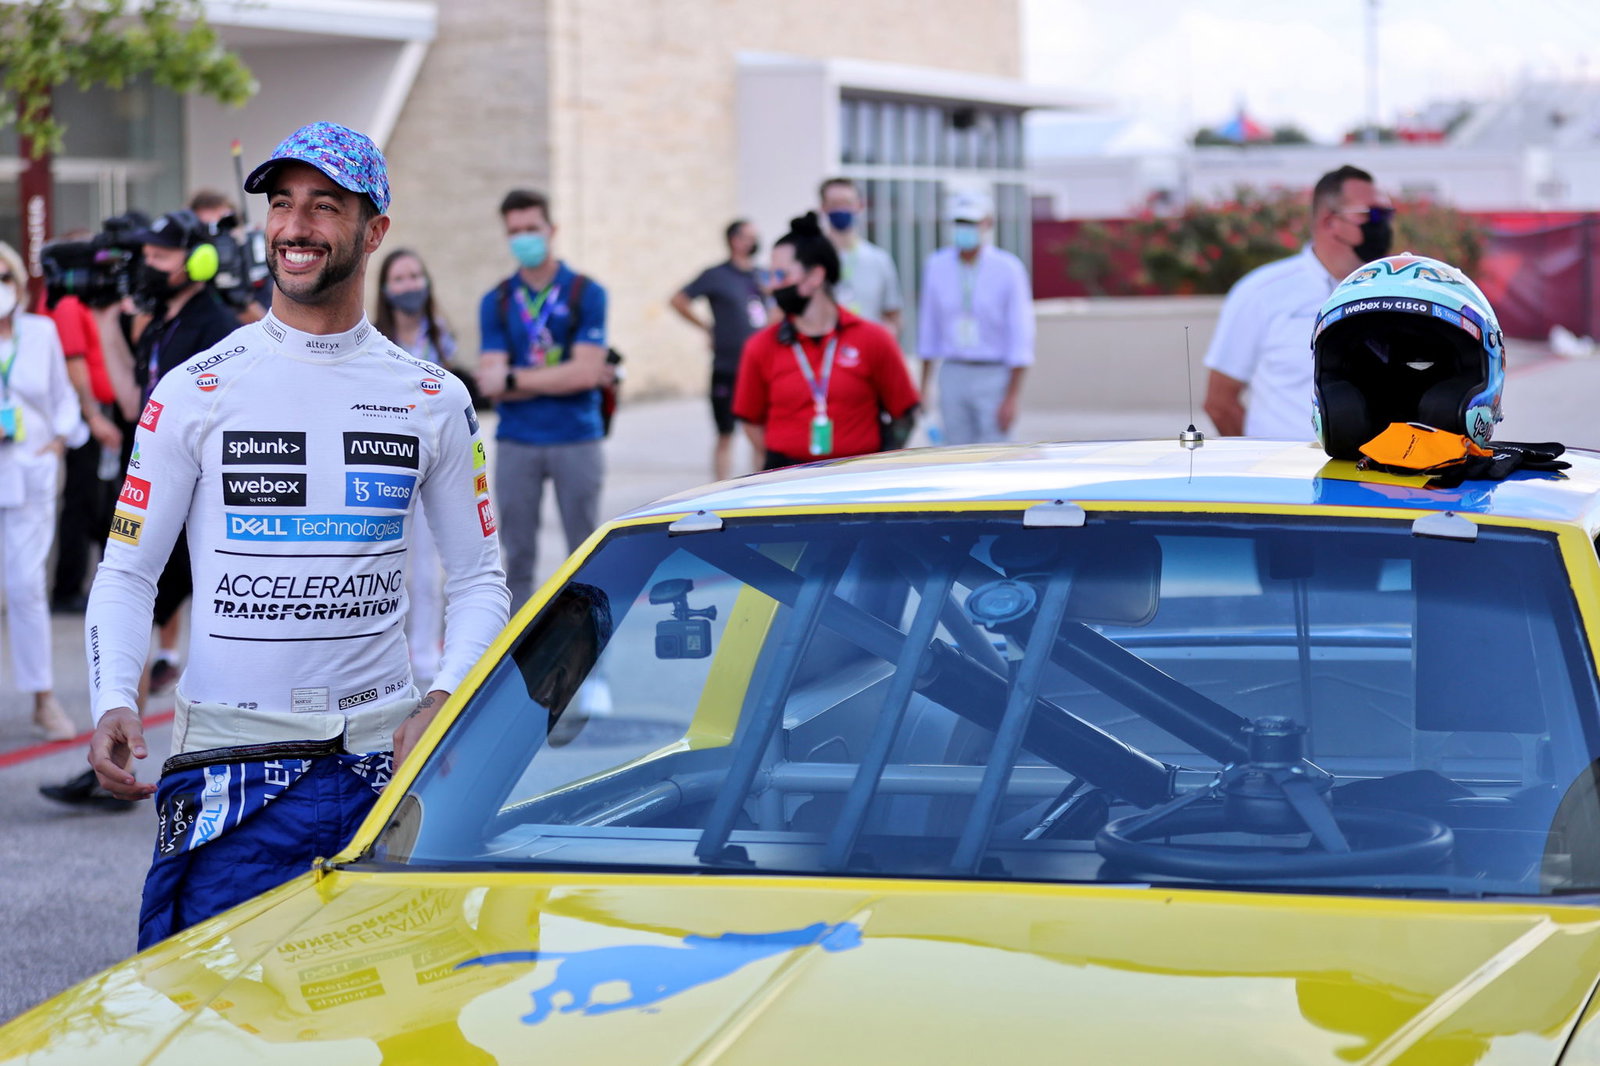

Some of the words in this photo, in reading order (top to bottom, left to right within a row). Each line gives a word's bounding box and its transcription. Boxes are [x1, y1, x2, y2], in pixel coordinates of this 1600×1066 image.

[1344, 301, 1380, 314] webex
[1382, 302, 1393, 310] by
[1394, 301, 1428, 312] CISCO
[305, 340, 340, 350] alteryx
[186, 345, 247, 373] sparco
[196, 378, 219, 387] Gulf
[420, 381, 442, 390] Gulf
[350, 403, 409, 414] McLaren
[350, 440, 414, 458] ARROW
[228, 476, 300, 494] webex
[375, 481, 411, 500] Tezos
[231, 517, 288, 536] DELL
[291, 518, 401, 542] Technologies
[215, 569, 402, 599] ACCELERATING
[213, 598, 400, 621] TRANSFORMATION
[385, 683, 396, 695] DR
[339, 689, 377, 709] sparco
